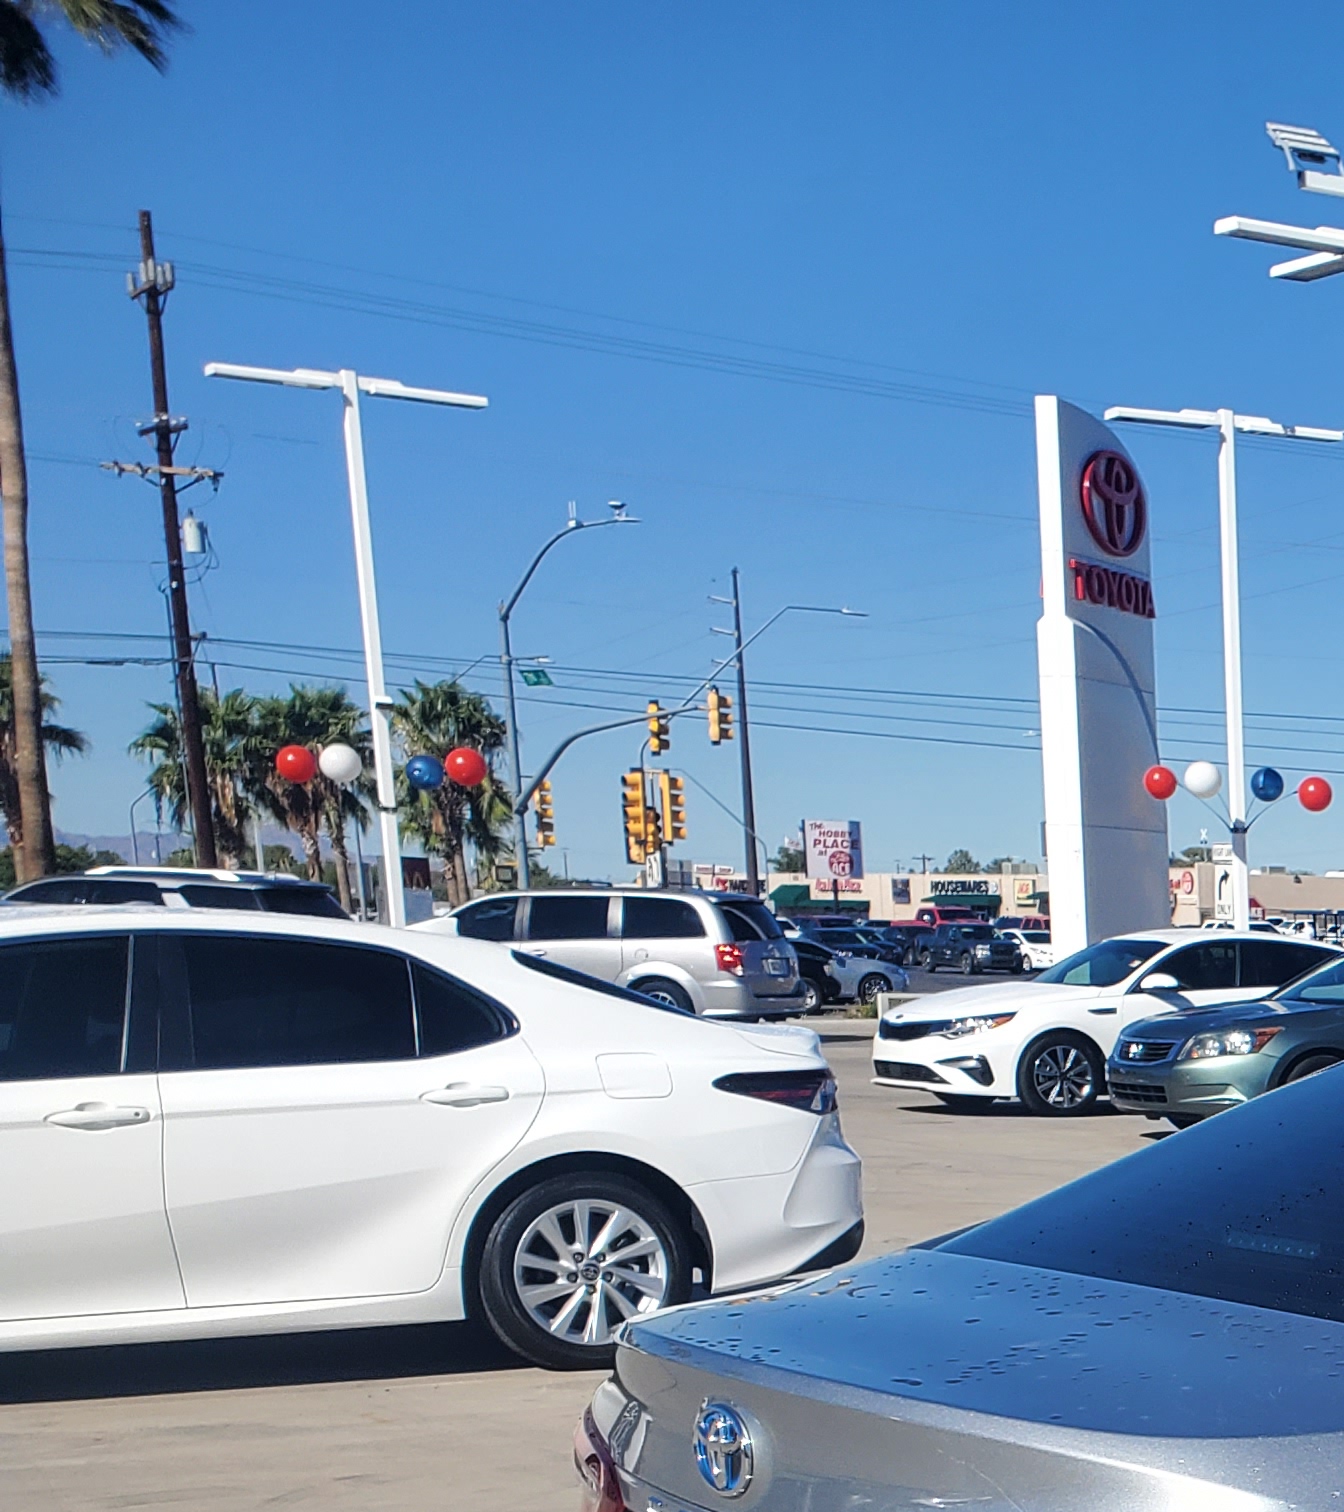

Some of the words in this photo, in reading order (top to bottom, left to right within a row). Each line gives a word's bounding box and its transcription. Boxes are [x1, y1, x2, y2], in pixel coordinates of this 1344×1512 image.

[1069, 558, 1156, 619] TOYOTA
[818, 830, 852, 838] HOBBY
[813, 839, 860, 850] PLACE
[1217, 904, 1231, 915] ONLY
